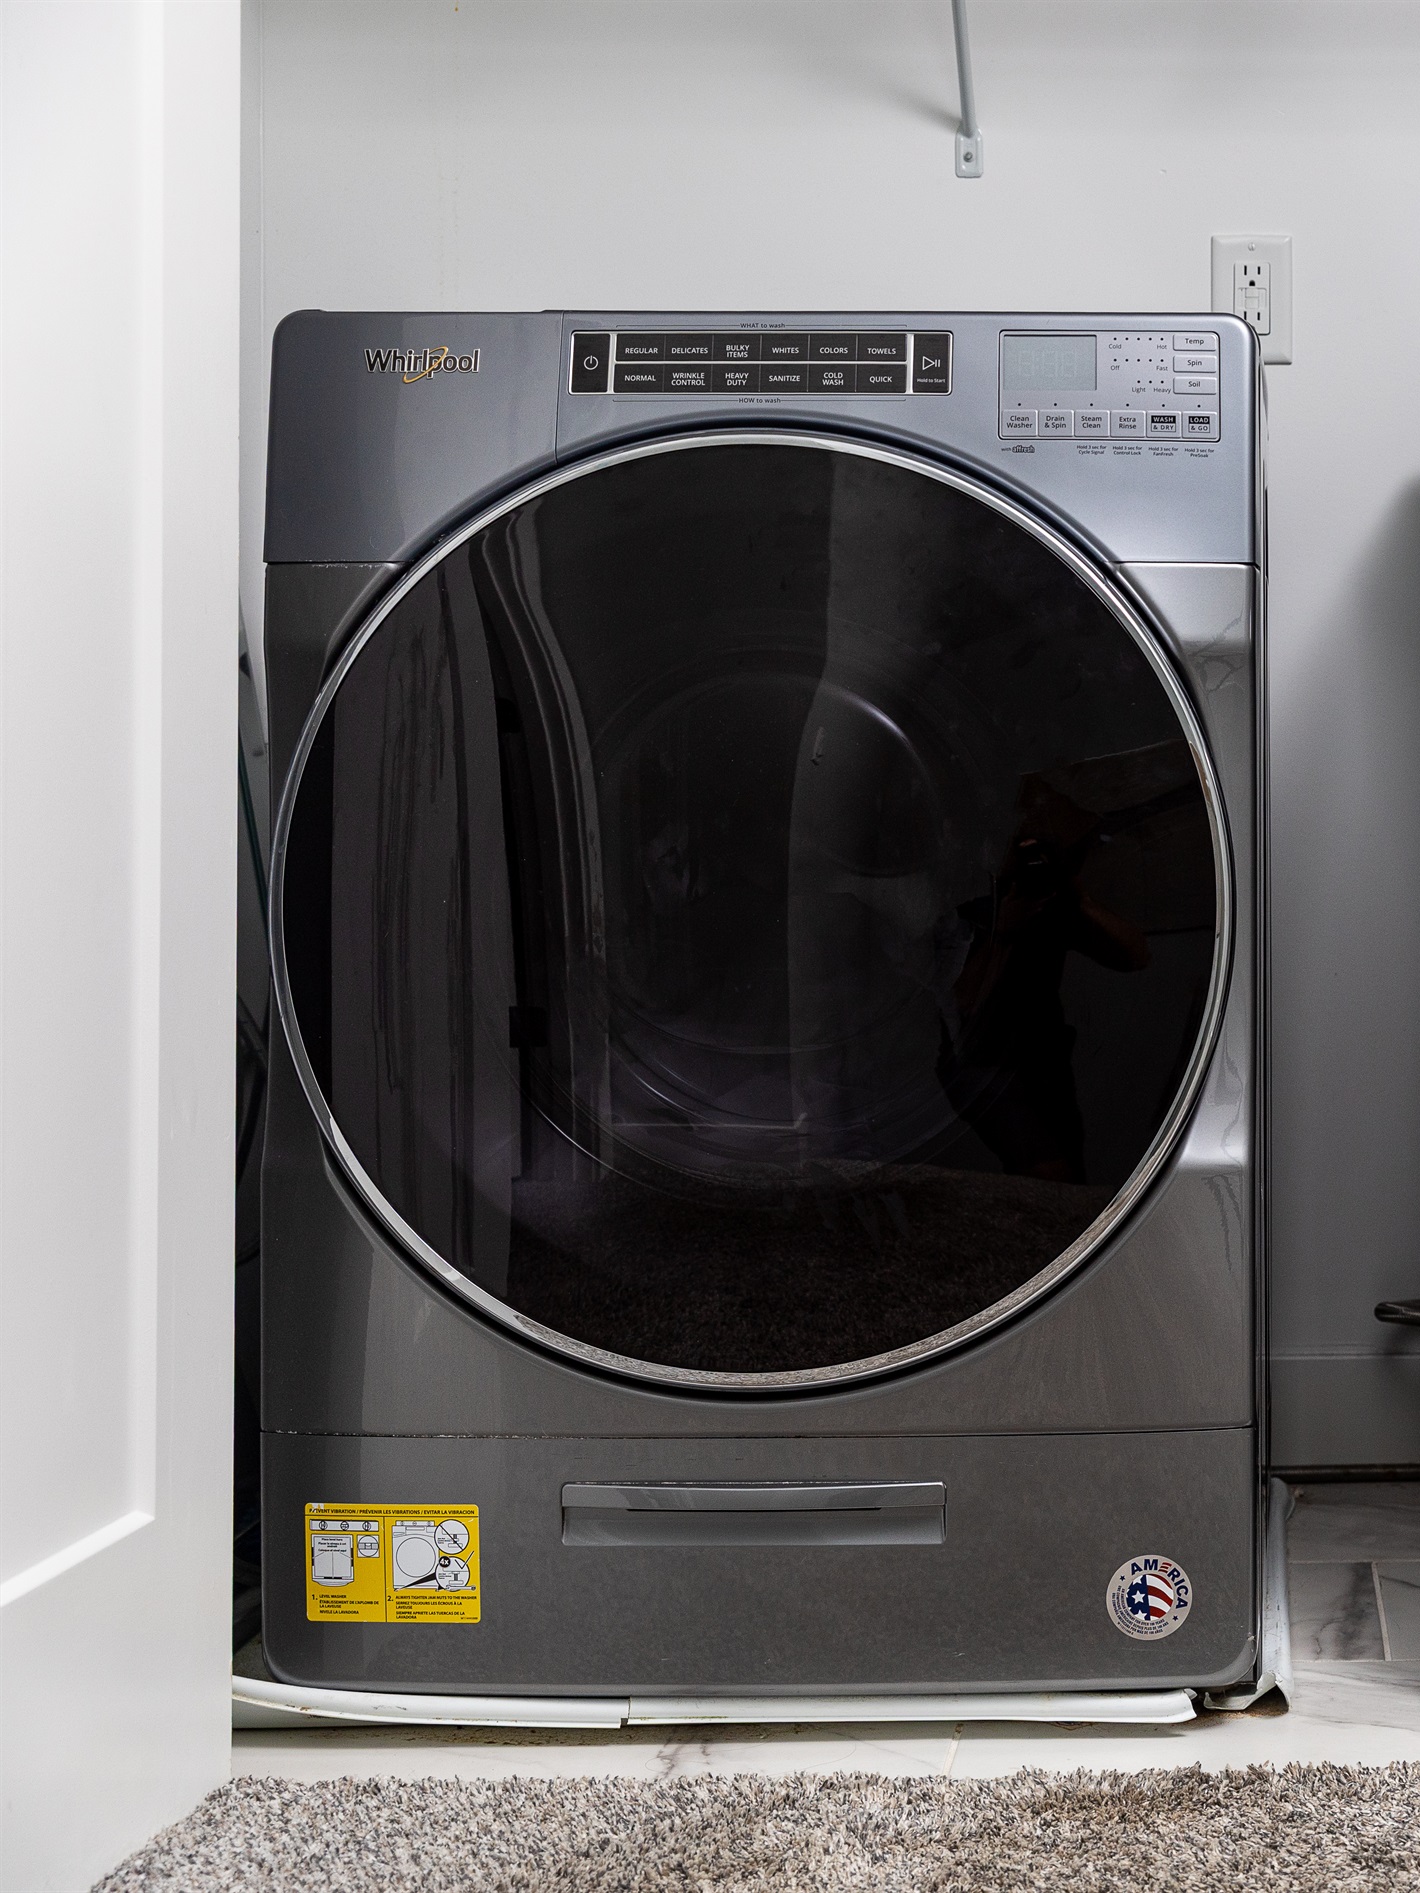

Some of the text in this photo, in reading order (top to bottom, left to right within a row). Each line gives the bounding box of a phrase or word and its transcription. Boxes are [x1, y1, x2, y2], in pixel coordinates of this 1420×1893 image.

[365, 347, 480, 380] Whirlpool
[1187, 359, 1202, 367] Spin
[1052, 422, 1066, 430] Spin
[440, 1557, 450, 1565] 4x
[1131, 1559, 1188, 1609] AMERICA
